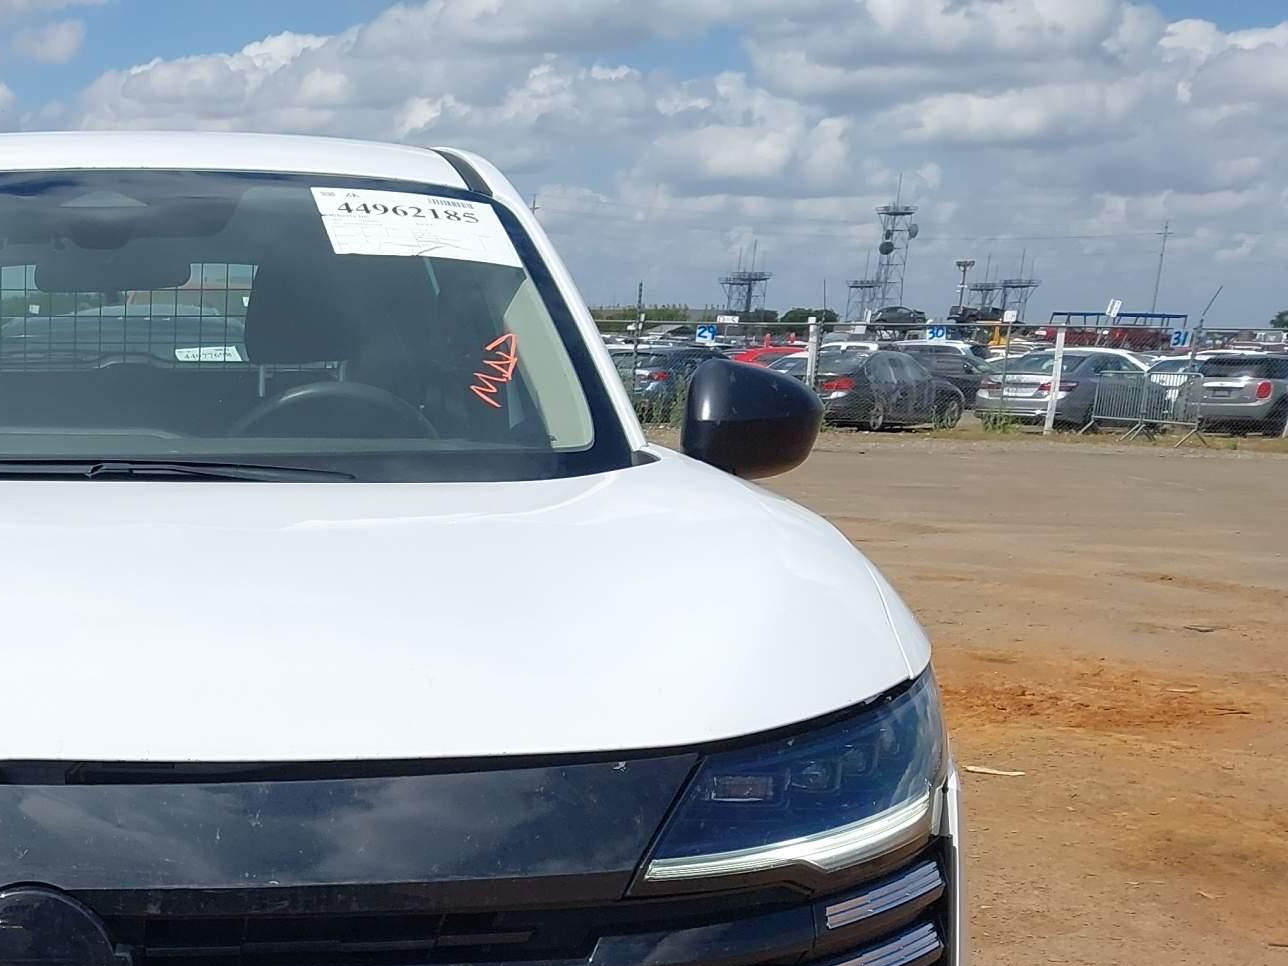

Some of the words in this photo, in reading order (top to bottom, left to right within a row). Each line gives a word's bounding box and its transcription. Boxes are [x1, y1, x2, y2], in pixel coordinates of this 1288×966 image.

[337, 202, 479, 224] 44962185
[697, 325, 716, 341] 29
[927, 326, 946, 340] 30
[1171, 331, 1189, 346] 31
